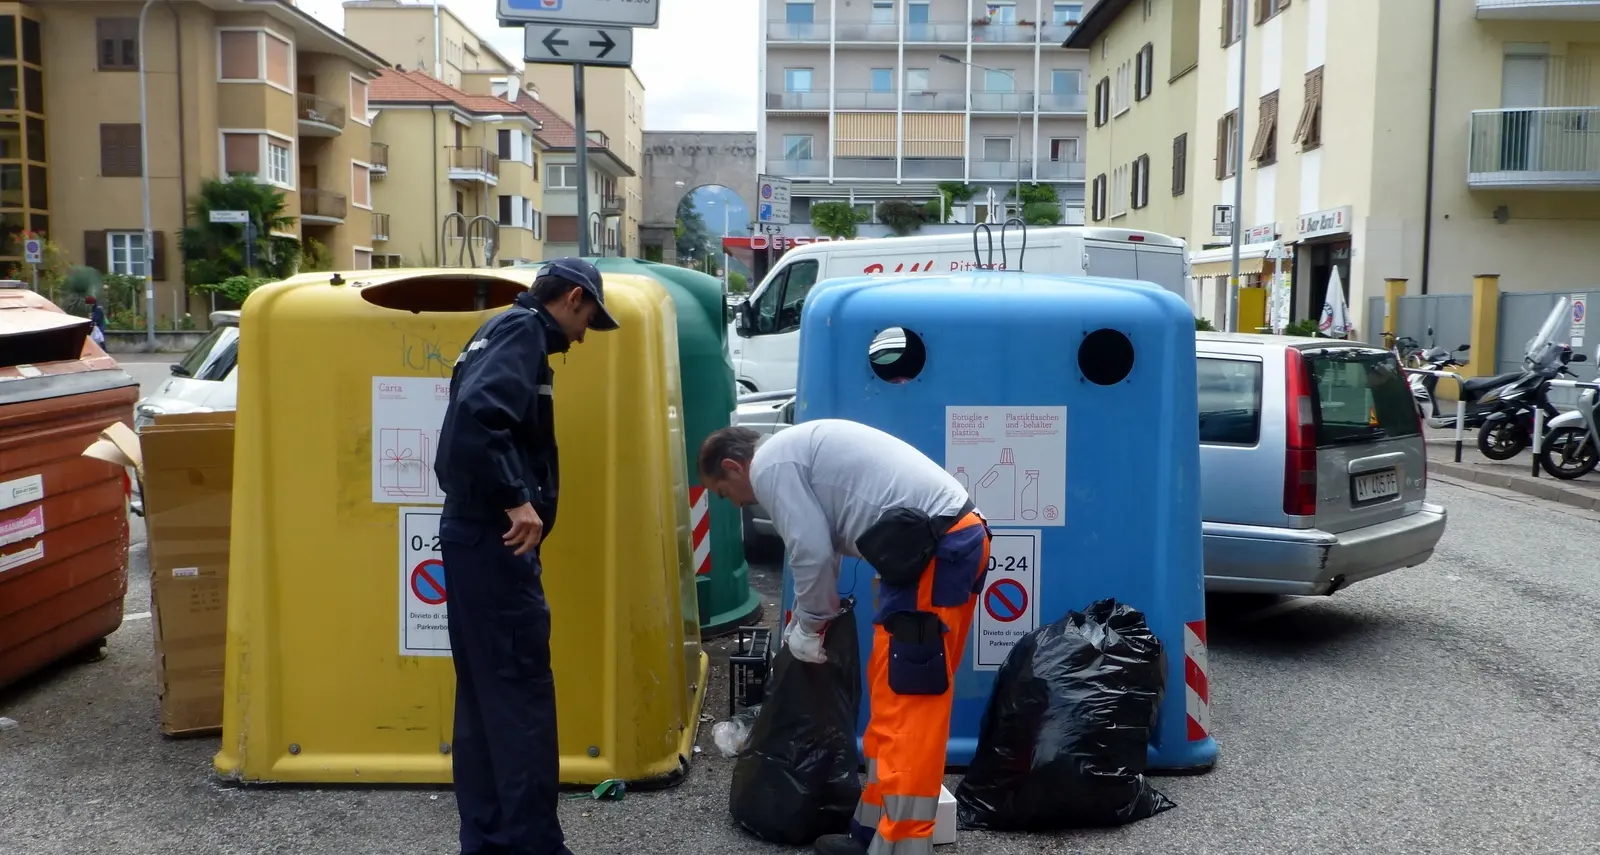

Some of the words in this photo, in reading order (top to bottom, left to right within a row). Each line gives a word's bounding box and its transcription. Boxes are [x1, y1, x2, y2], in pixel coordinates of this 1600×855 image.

[379, 382, 403, 393] Carta
[435, 384, 450, 395] Pap
[952, 413, 982, 422] Bottiglie
[1005, 413, 1059, 421] Plastikflaschen
[977, 421, 985, 429] di
[1005, 421, 1019, 429] und
[952, 429, 980, 437] plastica
[1372, 474, 1386, 495] 405
[411, 535, 442, 552] 0-2
[987, 556, 1029, 572] 0-24
[410, 612, 431, 620] Divieto
[433, 612, 440, 620] di
[416, 623, 448, 631] Parkverbo
